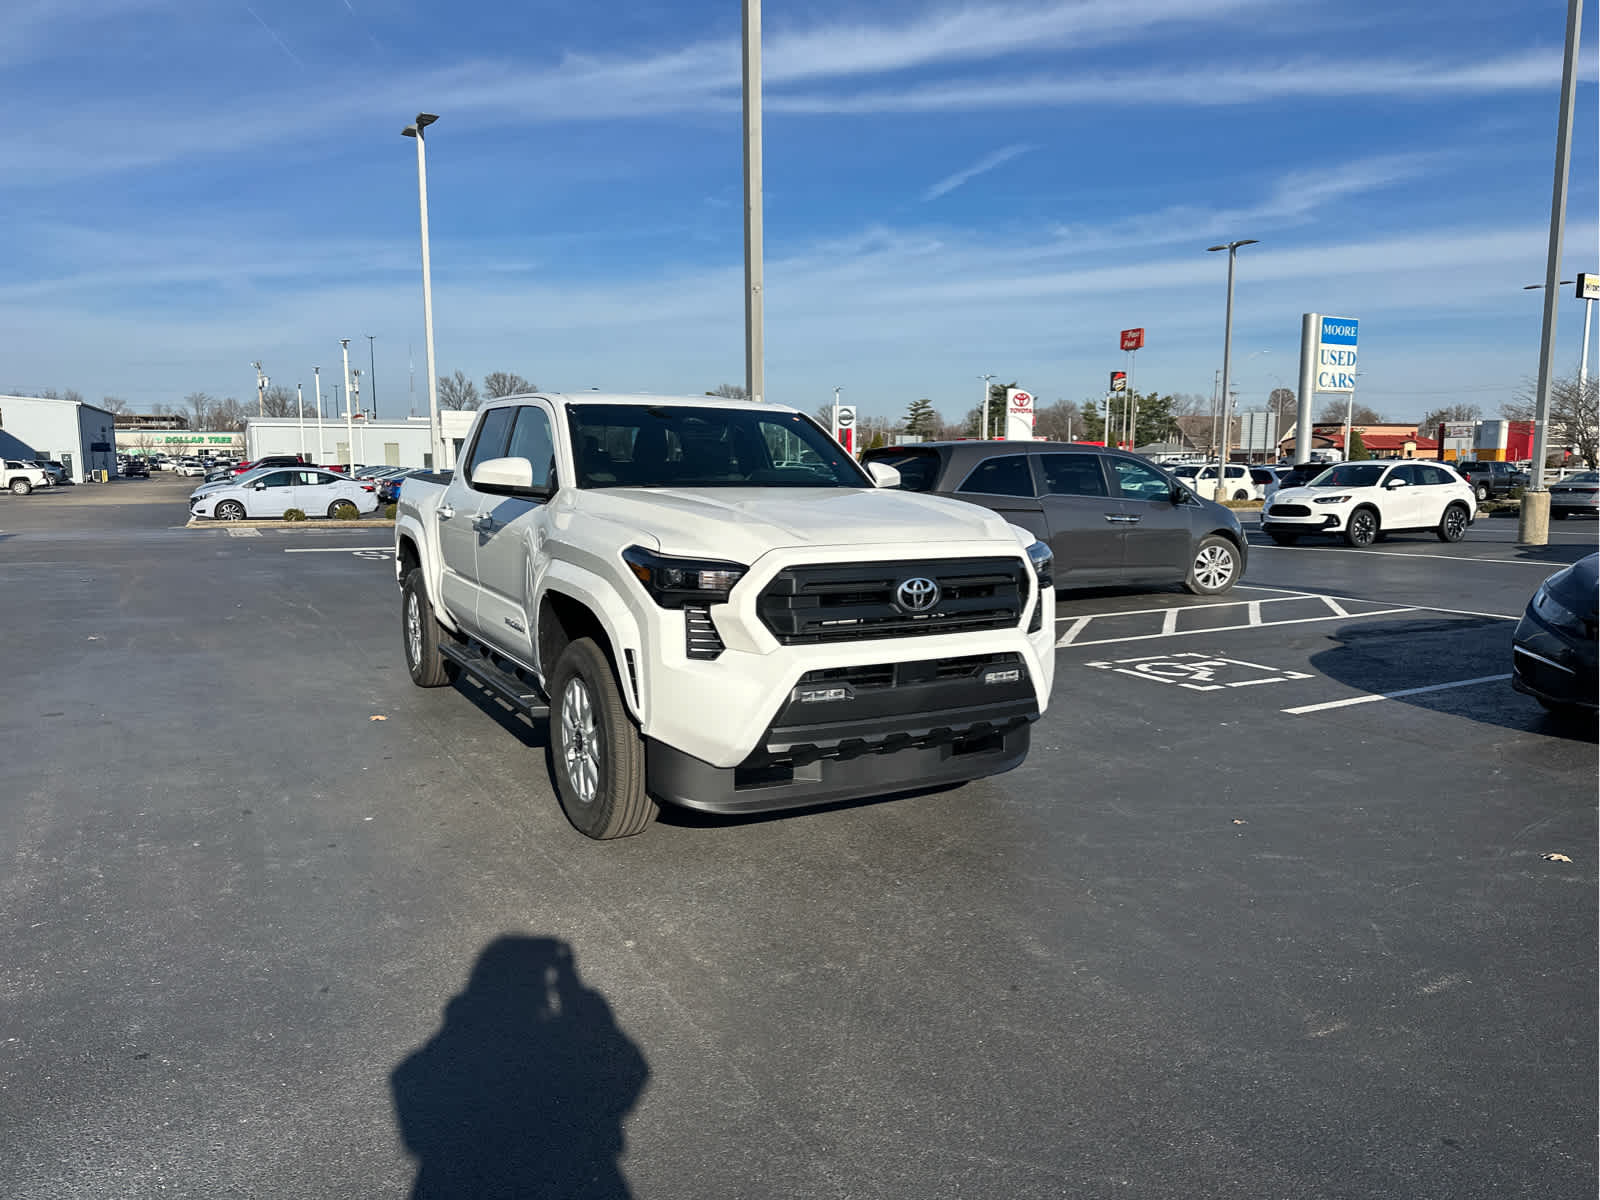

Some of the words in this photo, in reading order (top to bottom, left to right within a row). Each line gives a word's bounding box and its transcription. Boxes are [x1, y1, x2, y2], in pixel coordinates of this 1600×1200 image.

[1324, 324, 1357, 337] MOORE
[1321, 349, 1357, 366] USED
[1319, 371, 1355, 388] CARS
[165, 436, 204, 444] DOLLAR
[208, 436, 232, 444] TREE
